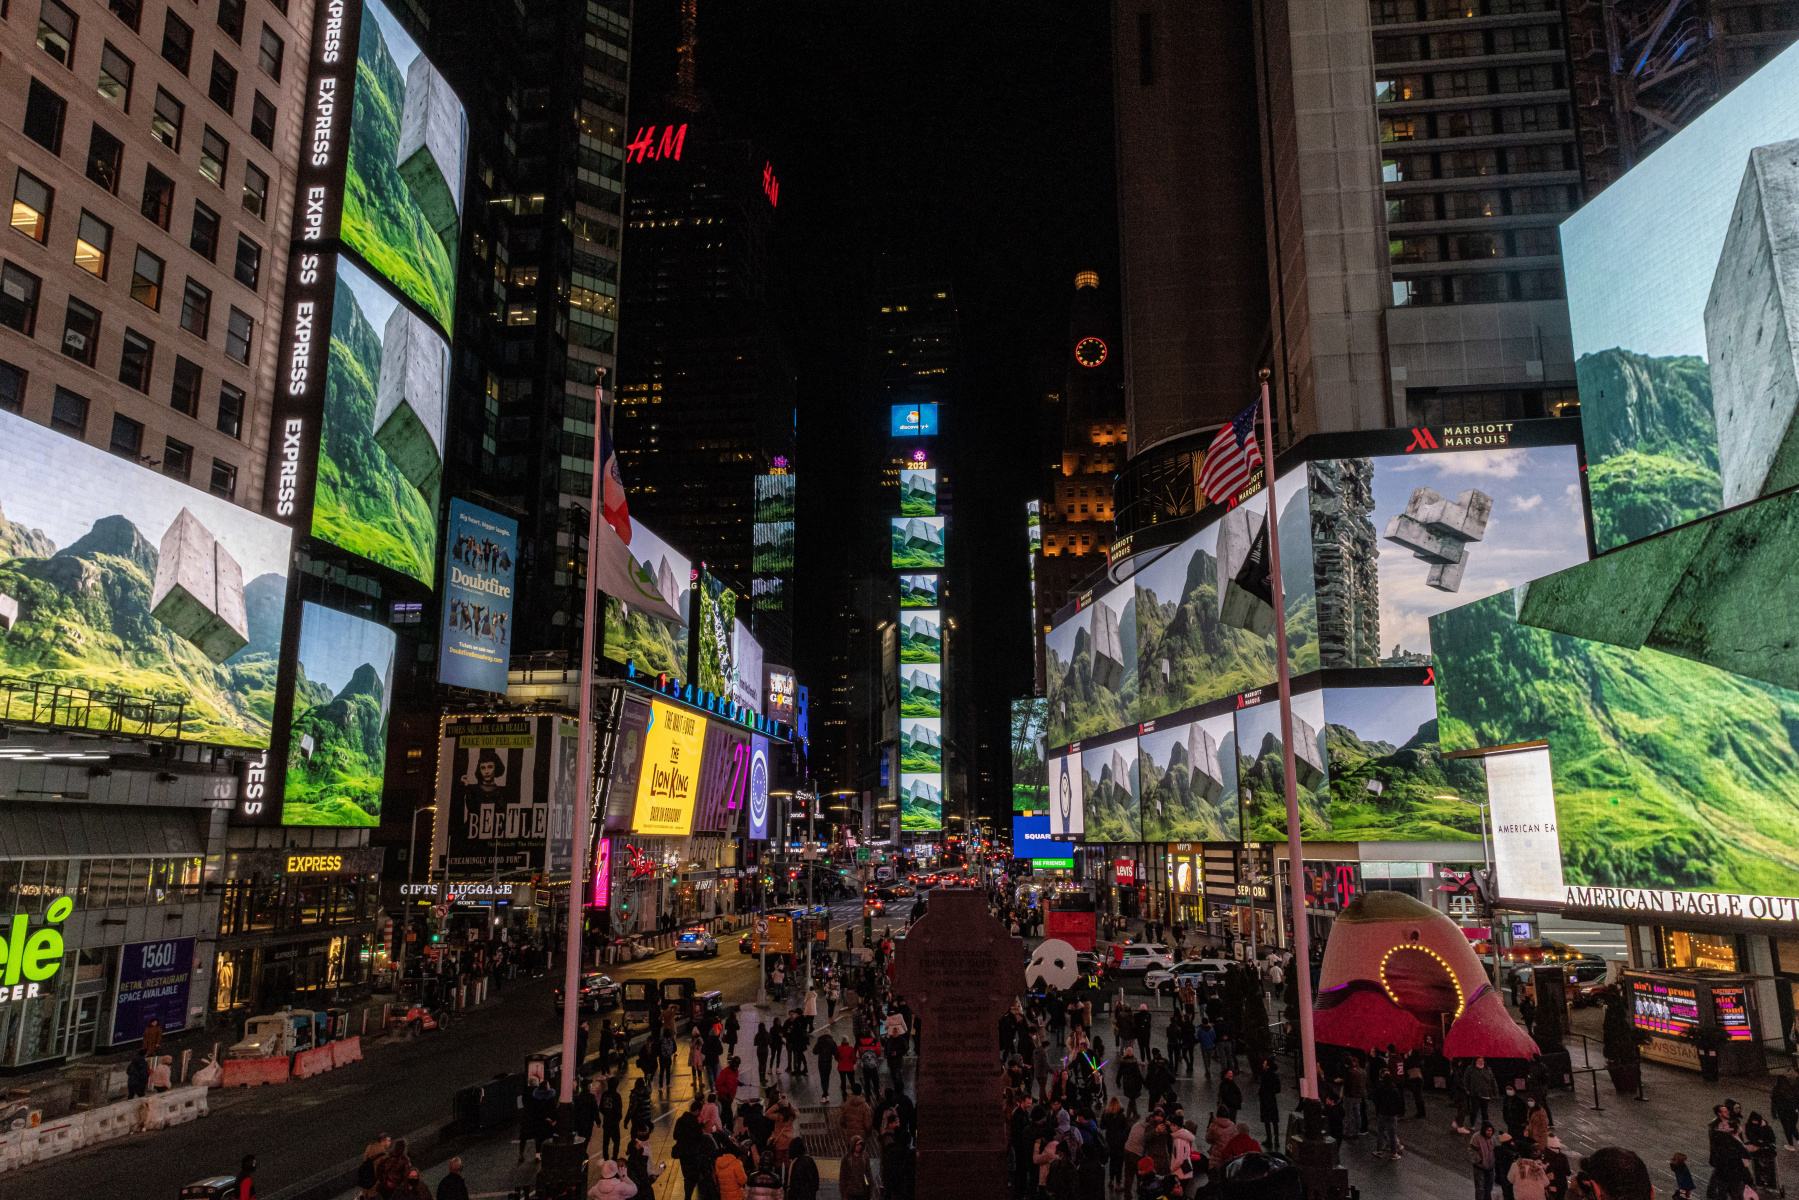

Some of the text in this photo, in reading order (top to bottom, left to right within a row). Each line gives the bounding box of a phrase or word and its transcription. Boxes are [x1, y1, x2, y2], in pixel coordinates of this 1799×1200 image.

[312, 78, 336, 166] EXPRESS
[626, 123, 688, 164] H&M
[300, 187, 325, 284] EXPRSS
[290, 302, 314, 396] EXPRESS
[1444, 423, 1514, 436] MARRIOTT
[1445, 435, 1507, 447] MARQUIS
[277, 419, 302, 516] EXPRESS
[907, 461, 927, 470] 2021
[1238, 482, 1261, 502] MARQUIS
[459, 513, 468, 522] Big
[450, 566, 511, 598] Doubtfire
[459, 641, 472, 650] Tickets
[466, 724, 491, 735] SQUARE
[505, 722, 528, 732] REALLY
[462, 736, 480, 746] MAKE
[670, 747, 680, 760] THE
[468, 807, 545, 839] BEETLE
[1498, 823, 1541, 834] AMERICAN
[1024, 833, 1052, 841] SQUAR
[287, 855, 342, 873] EXPRESS
[488, 856, 504, 864] GOOD
[400, 884, 512, 895] GIFTS LUGGAGE
[1237, 885, 1267, 898] SEPORA
[1564, 886, 1665, 912] AMERICAN
[1669, 891, 1743, 917] EAGLE
[0, 896, 73, 985] lé
[141, 942, 172, 969] 1560
[118, 985, 179, 1004] SPACE AVAILABLE
[1633, 981, 1696, 999] ain't too proud
[1715, 995, 1737, 1004] ain't
